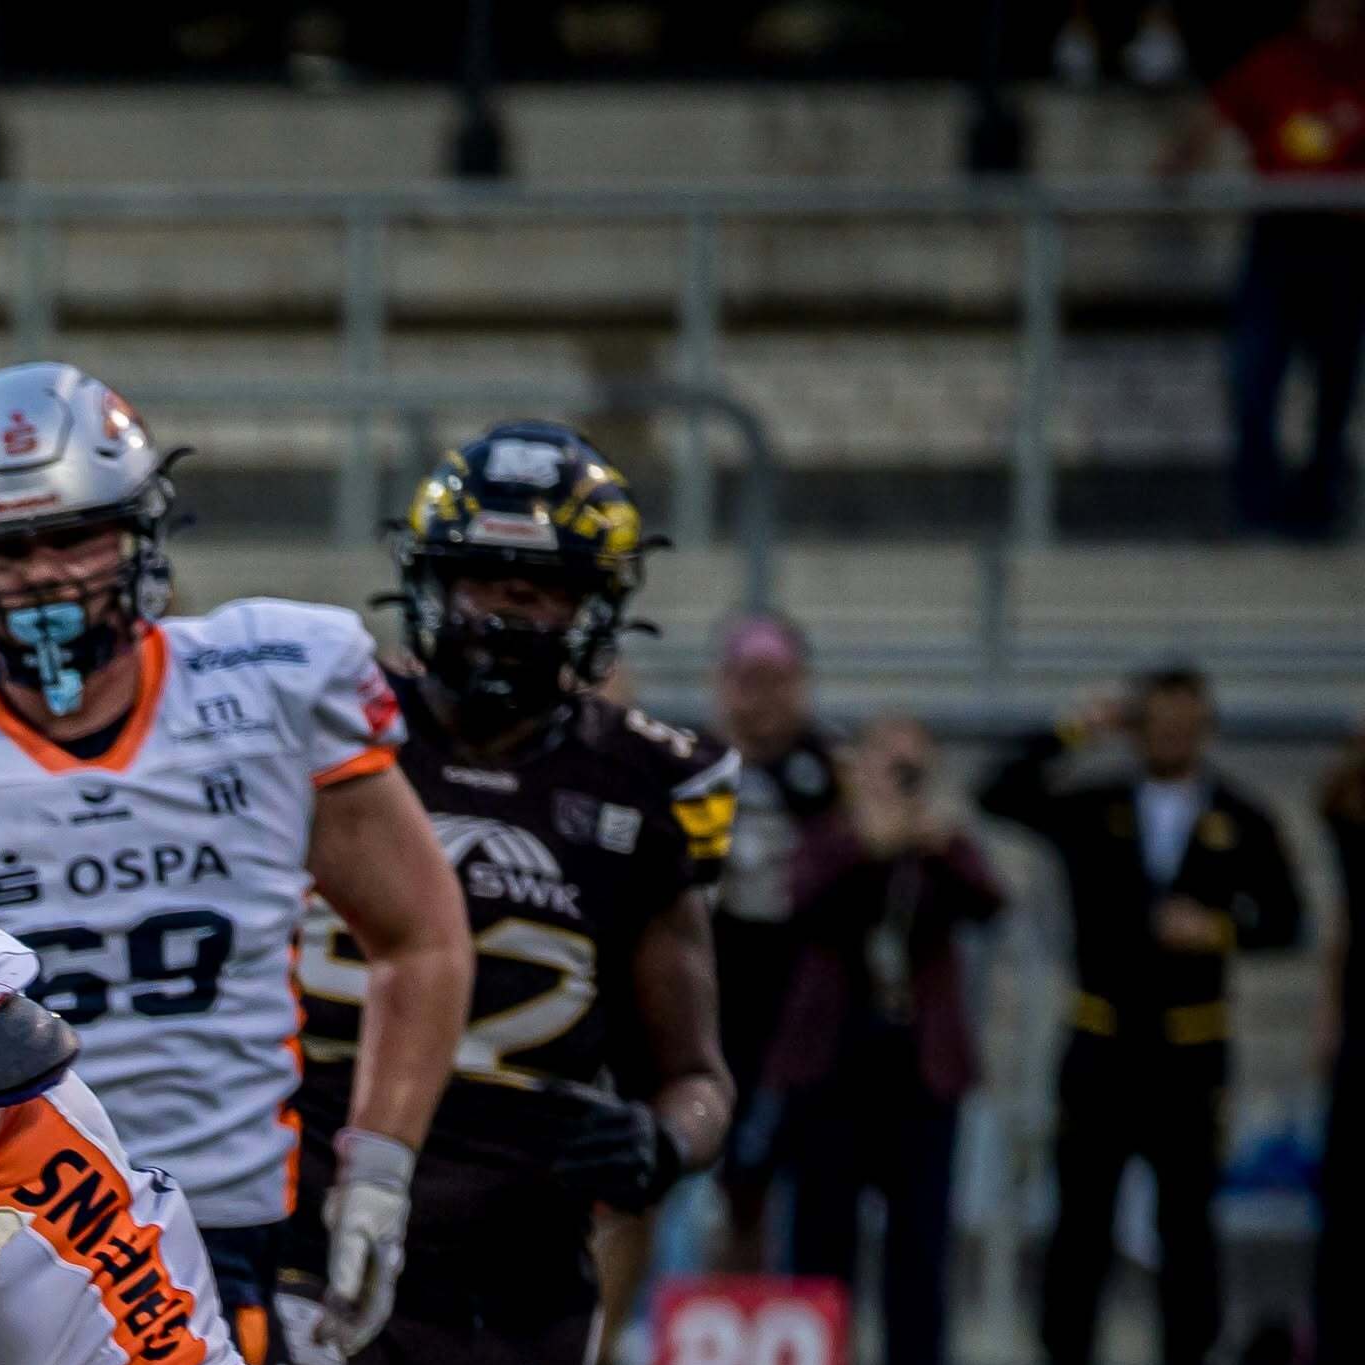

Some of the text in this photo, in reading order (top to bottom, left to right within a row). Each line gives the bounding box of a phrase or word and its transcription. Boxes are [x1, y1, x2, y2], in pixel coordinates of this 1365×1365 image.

[68, 844, 229, 896] OSPA
[18, 910, 233, 1024] 69
[12, 1148, 189, 1361] GRIFINS
